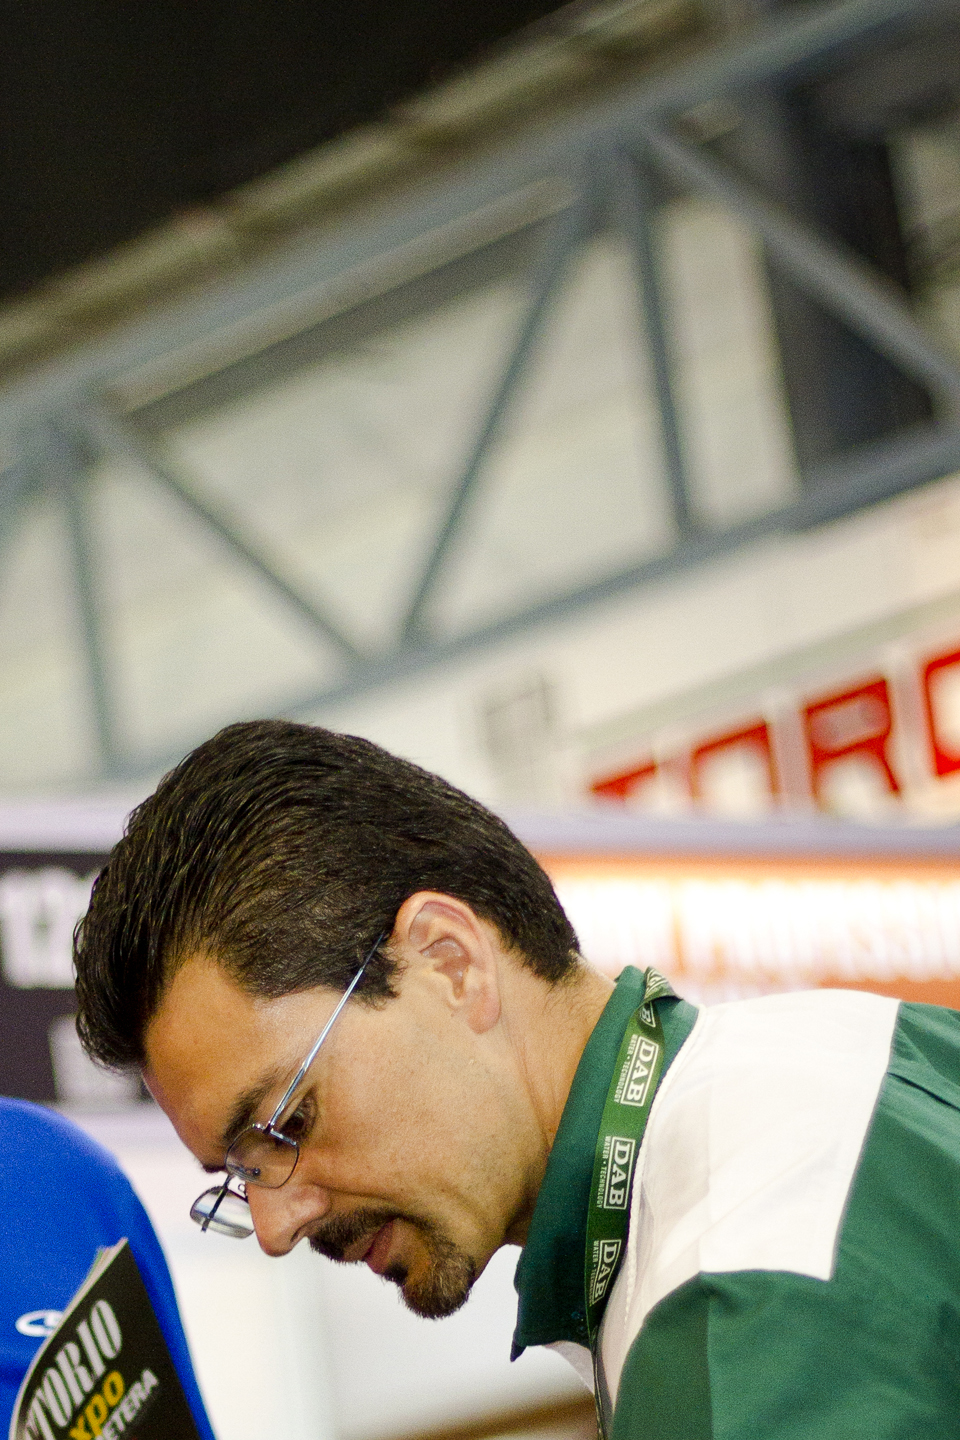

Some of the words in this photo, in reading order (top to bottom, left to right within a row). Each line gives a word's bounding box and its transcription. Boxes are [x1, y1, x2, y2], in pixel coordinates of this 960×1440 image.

[627, 1041, 655, 1101] DAB
[602, 1135, 611, 1159] WATER
[608, 1141, 630, 1205] DAB
[595, 1244, 617, 1298] DAB
